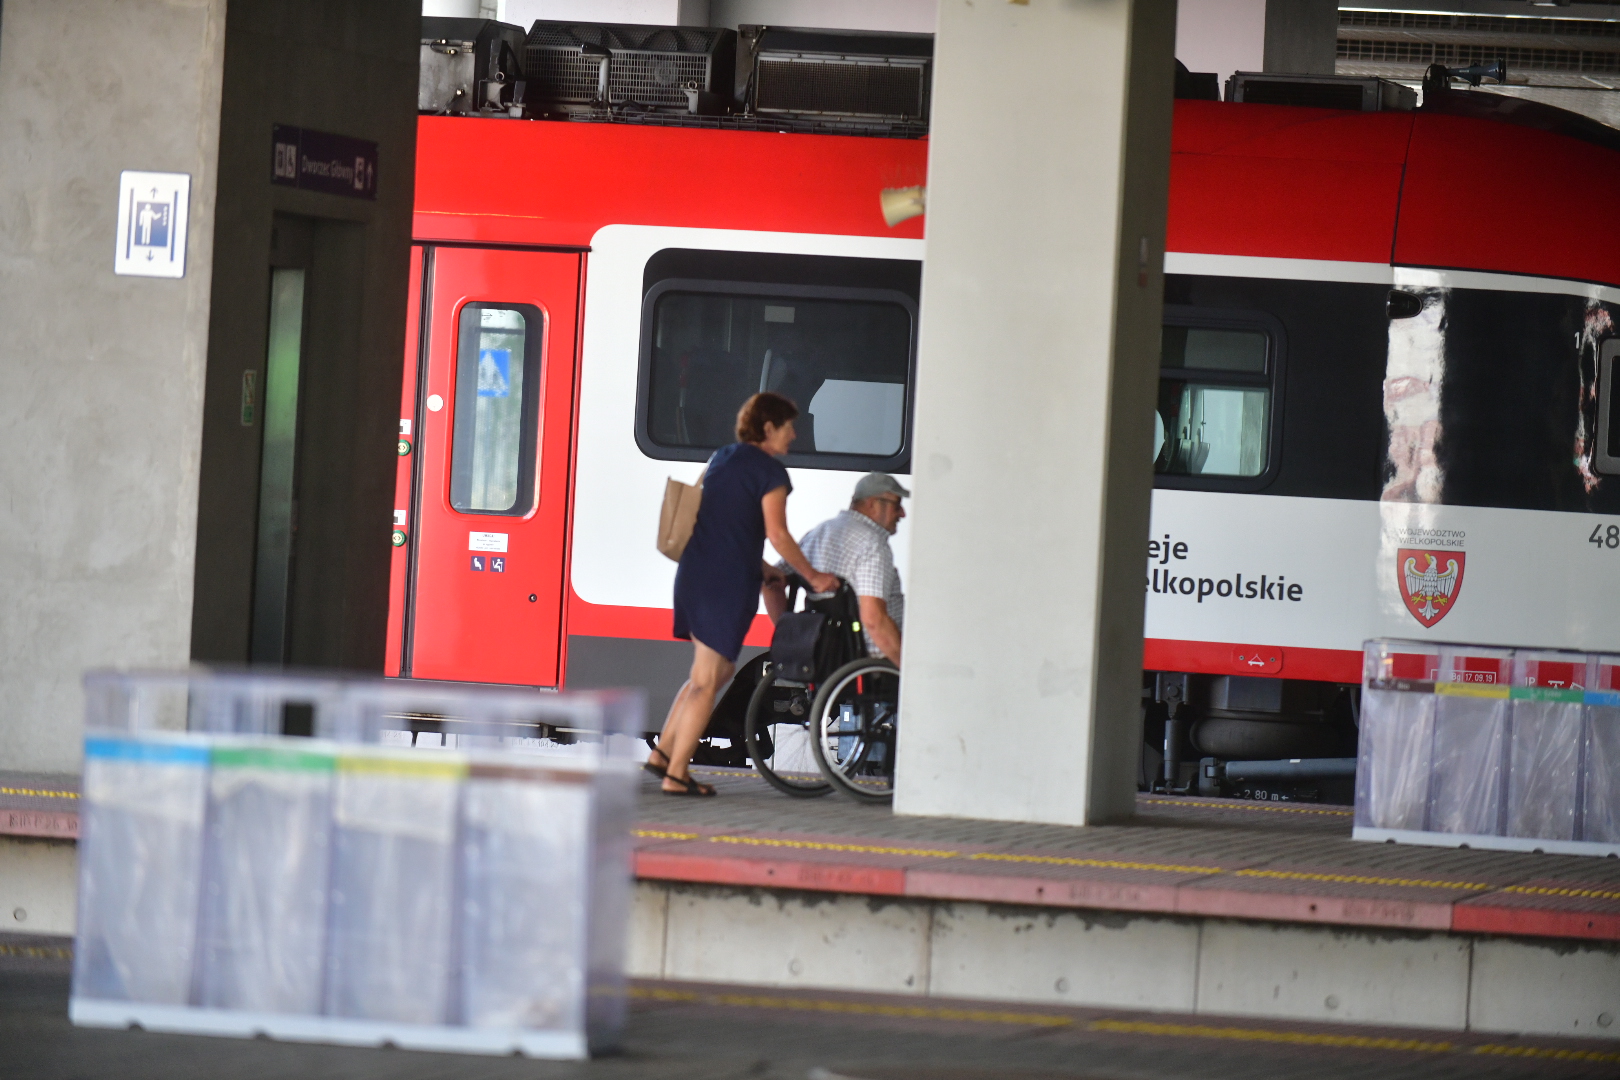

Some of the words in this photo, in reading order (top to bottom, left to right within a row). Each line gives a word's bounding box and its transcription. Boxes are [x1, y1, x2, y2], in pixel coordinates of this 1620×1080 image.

[302, 154, 331, 177] Dworzec
[1574, 331, 1580, 349] 1
[1399, 528, 1466, 538] WOJEWÓDZTWO
[1399, 538, 1465, 547] WIELKOPOLSKIE
[1588, 523, 1620, 549] 48
[1146, 568, 1304, 604] lkopolskie
